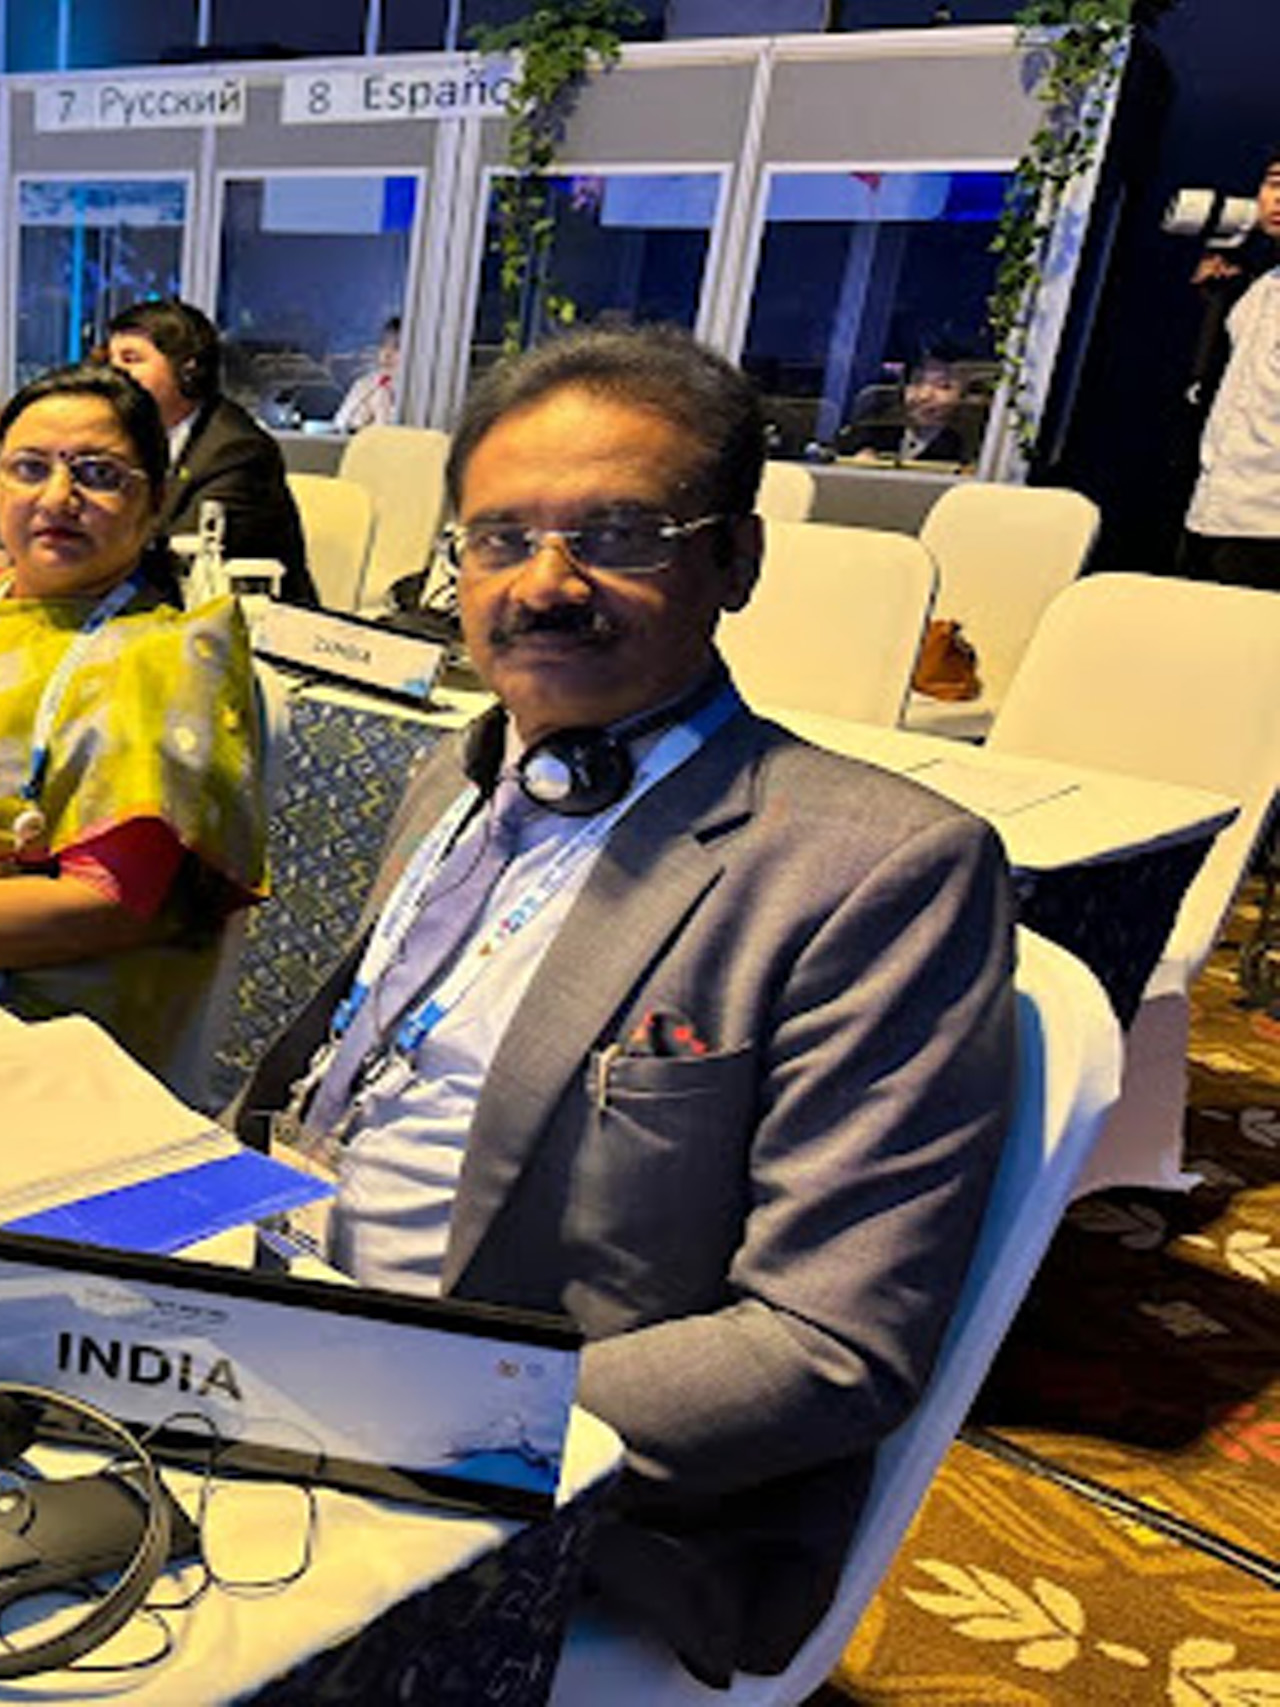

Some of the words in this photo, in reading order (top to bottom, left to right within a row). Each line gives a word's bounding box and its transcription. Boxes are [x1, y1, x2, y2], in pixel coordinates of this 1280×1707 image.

[57, 89, 77, 123] 7
[99, 78, 242, 125] Русский
[307, 81, 332, 115] 8
[363, 67, 517, 113] Españo
[57, 1331, 243, 1402] INDIA
